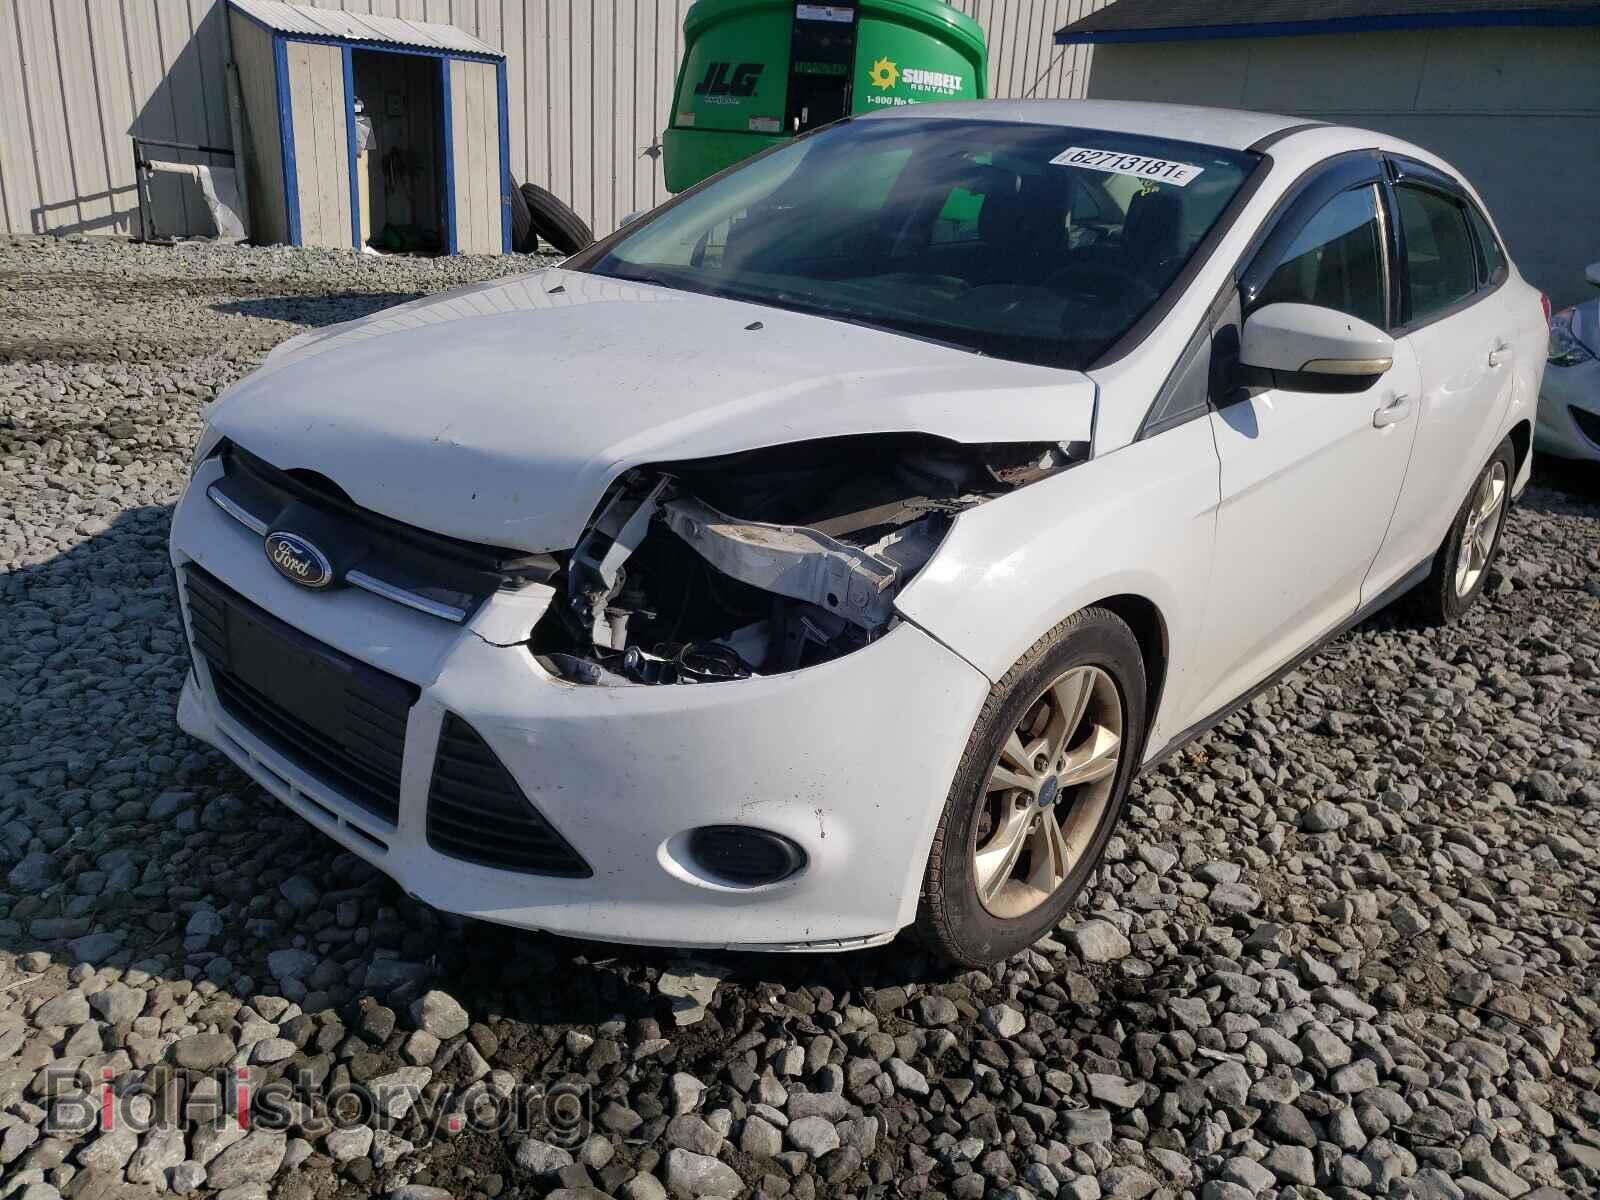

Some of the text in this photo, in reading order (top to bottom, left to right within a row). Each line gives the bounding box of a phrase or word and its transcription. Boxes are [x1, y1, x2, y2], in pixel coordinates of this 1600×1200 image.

[694, 62, 765, 96] JLG
[902, 68, 962, 90] SUNBELT
[911, 84, 955, 95] RENTALS
[1070, 150, 1177, 177] 62713181
[274, 541, 311, 576] Ford
